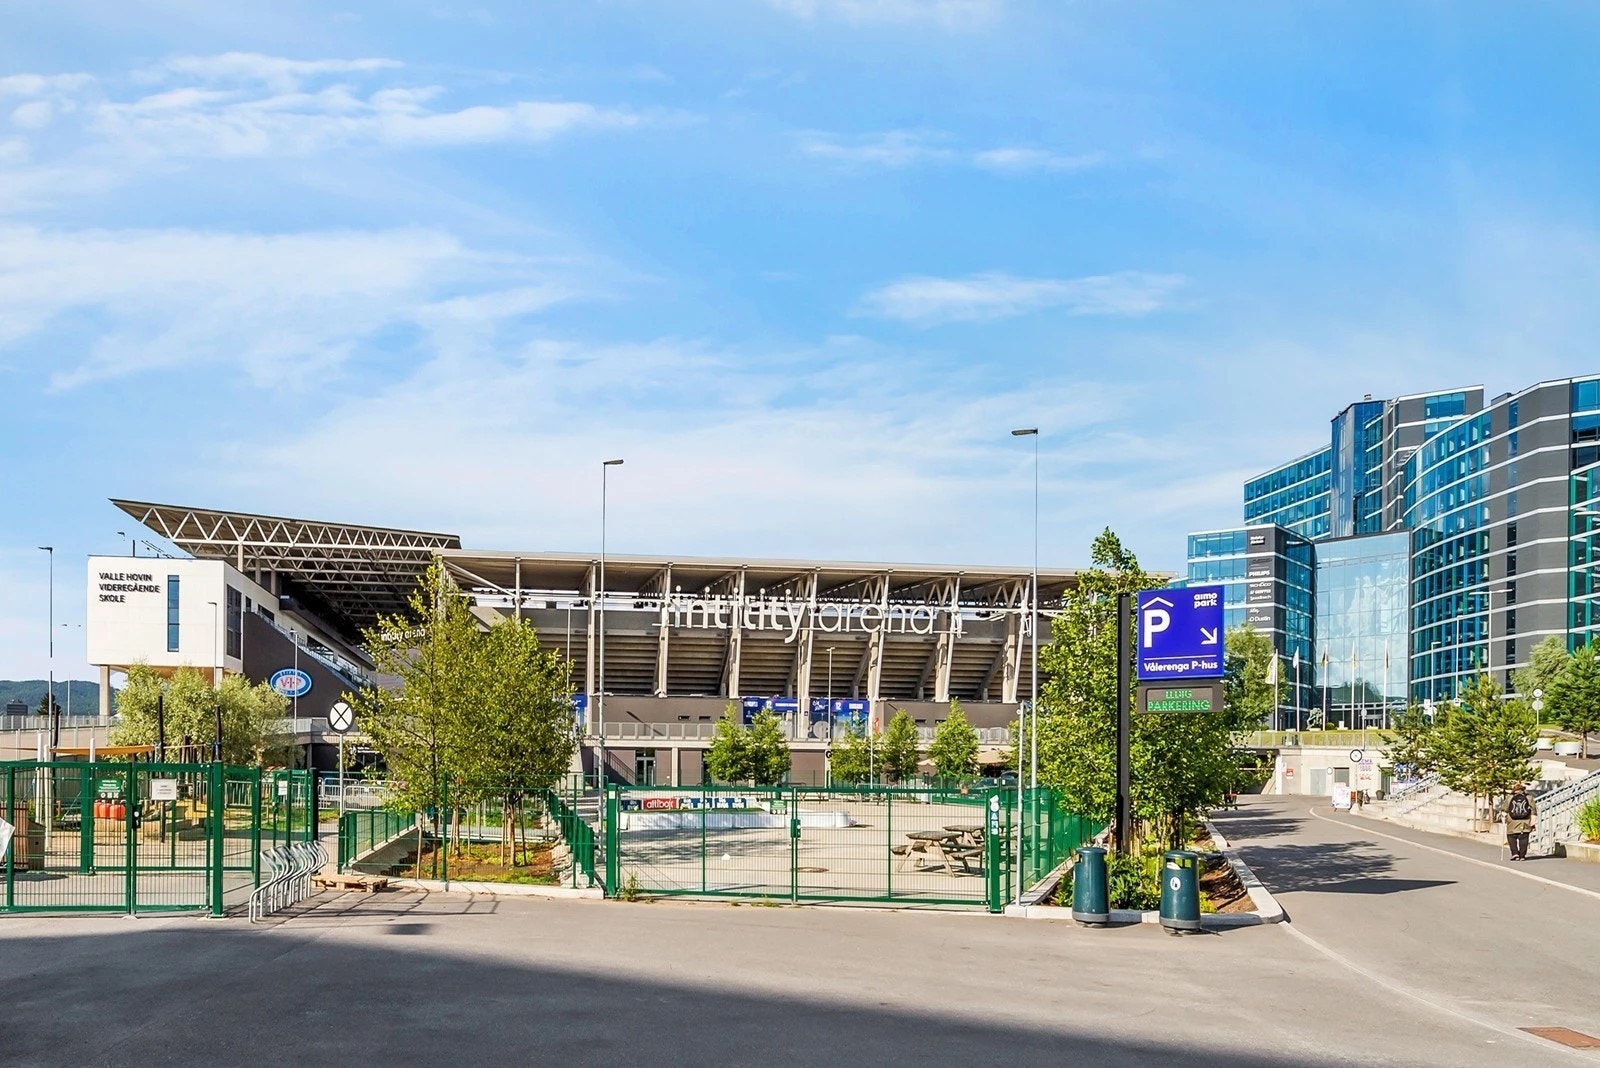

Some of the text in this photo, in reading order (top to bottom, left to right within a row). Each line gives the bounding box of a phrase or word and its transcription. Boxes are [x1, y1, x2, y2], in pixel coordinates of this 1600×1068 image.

[98, 572, 153, 582] VALLE HOVIN
[98, 582, 161, 593] VIDEREGÅENDE
[98, 594, 126, 603] SKOLE
[1193, 599, 1218, 609] park
[818, 603, 935, 634] arena
[1143, 609, 1171, 648] P
[1143, 660, 1218, 673] Vålerenga P-hus
[1147, 700, 1212, 712] PARKERING
